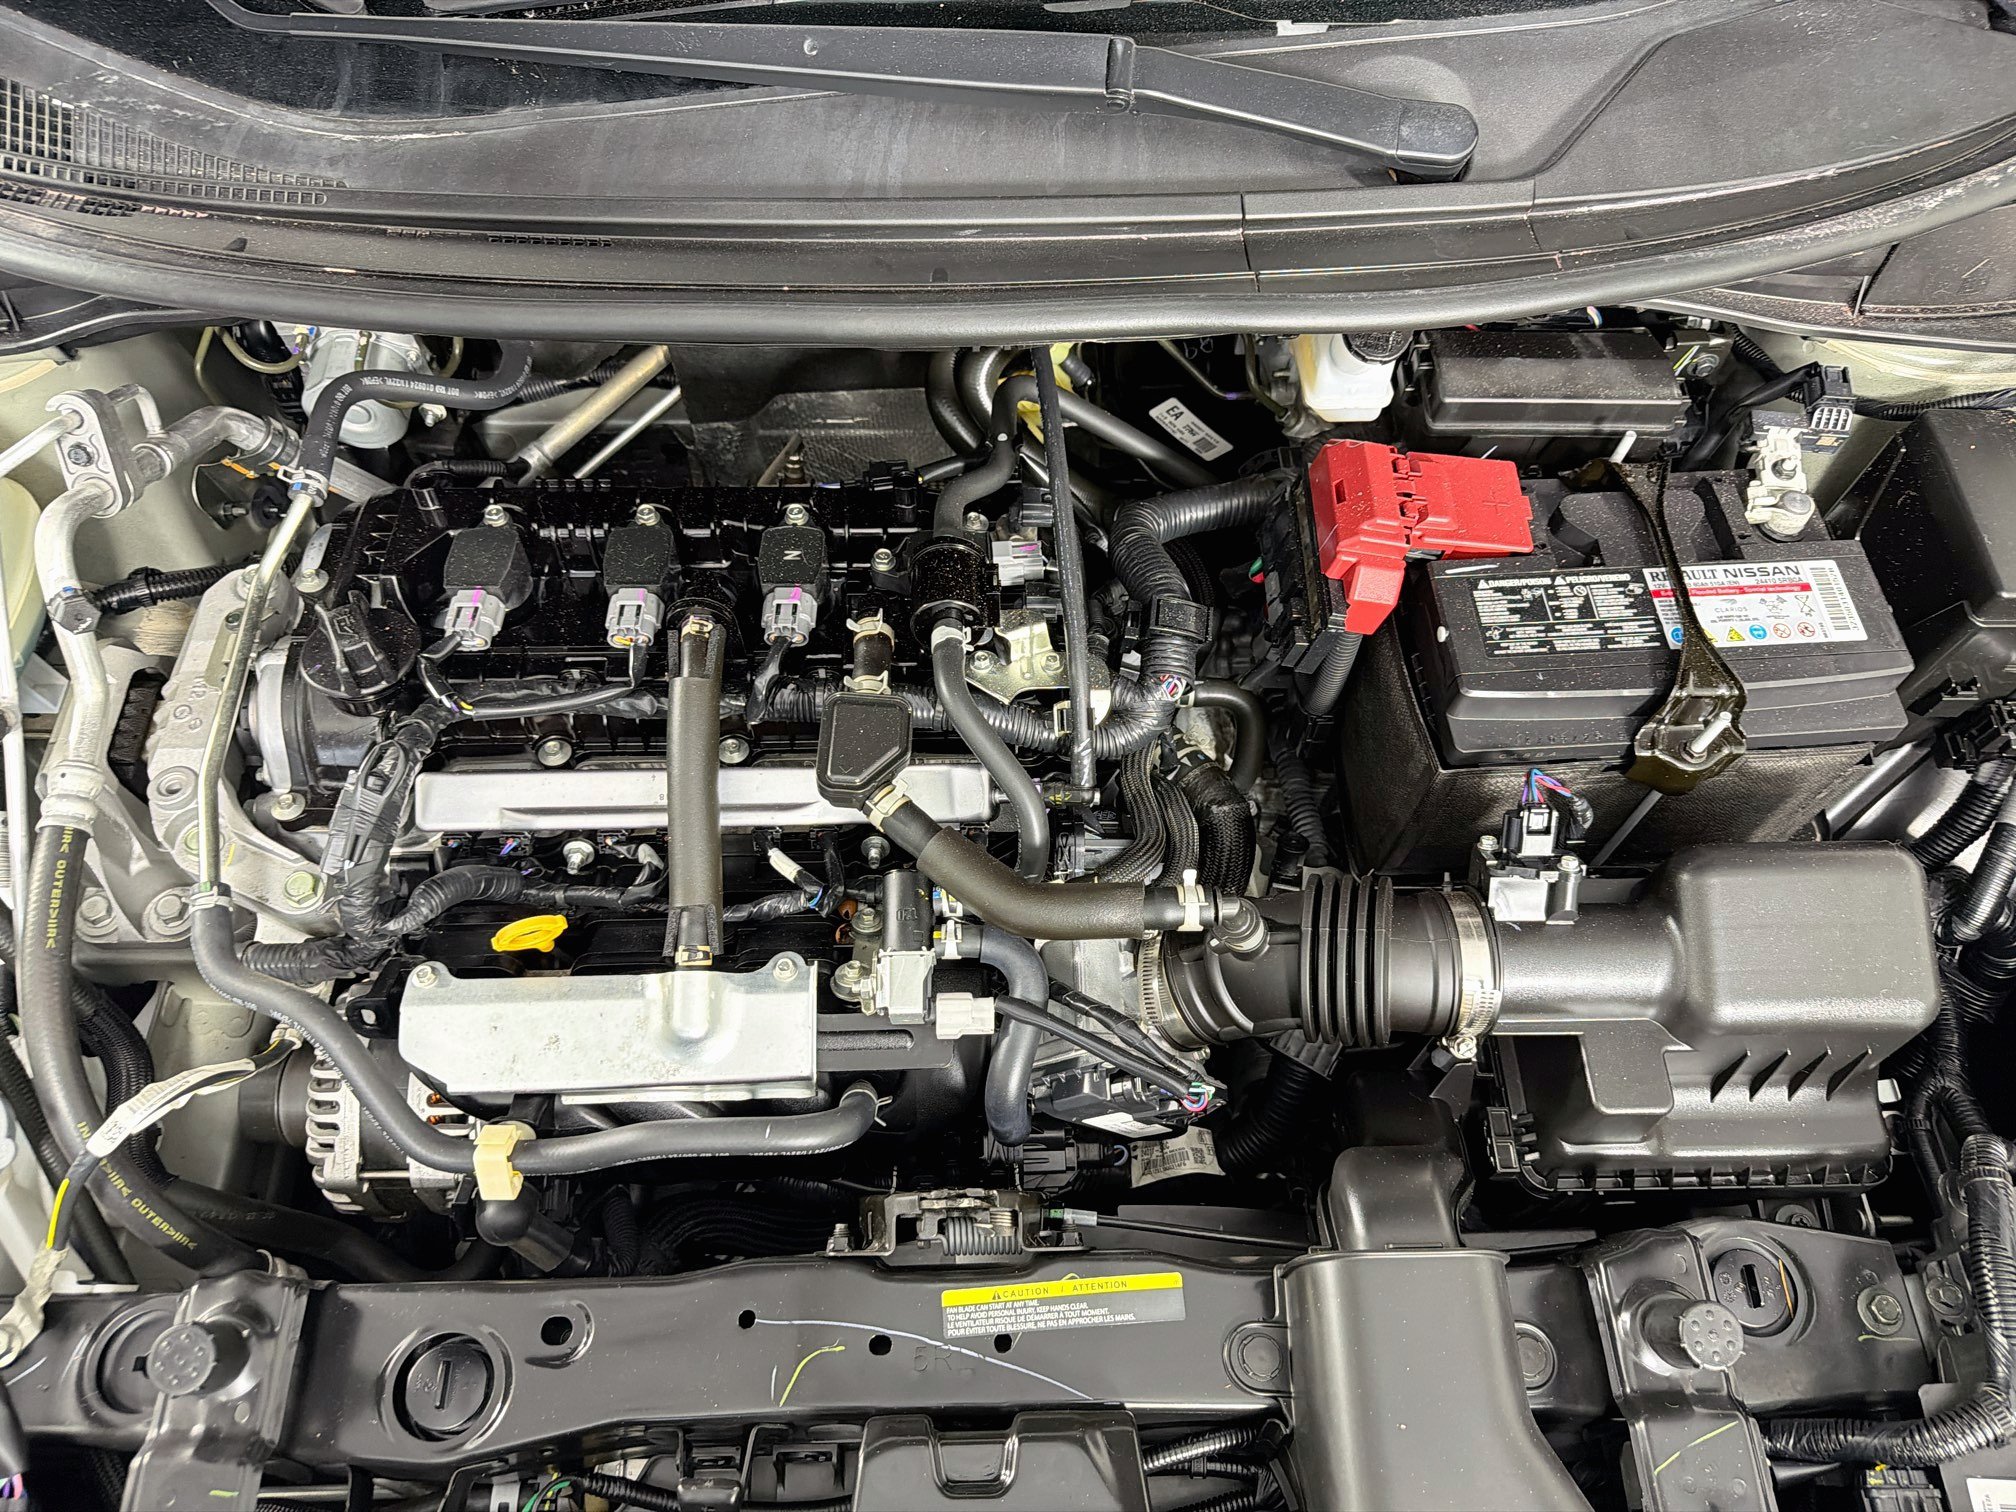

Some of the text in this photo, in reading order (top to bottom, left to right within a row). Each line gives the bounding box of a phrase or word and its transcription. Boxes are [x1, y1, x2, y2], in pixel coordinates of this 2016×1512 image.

[1165, 405, 1185, 421] EA
[1649, 565, 1801, 582] REAULT NISSAN
[1002, 1287, 1049, 1298] CAUTION
[1072, 1281, 1128, 1292] ATTENTION
[947, 1314, 955, 1322] TO
[956, 1313, 970, 1321] HELP
[970, 1311, 987, 1319] AVOID
[988, 1309, 1016, 1318] PERSONAL
[1036, 1305, 1049, 1313] KEEP
[1050, 1303, 1069, 1312] HANDS
[1070, 1302, 1088, 1310] CLEAR.
[958, 1305, 975, 1313] BLADE
[989, 1302, 1005, 1310] START
[1006, 1301, 1013, 1309] AT
[1013, 1300, 1025, 1308] ANY
[948, 1328, 965, 1336] POUR
[966, 1326, 985, 1335] ÉVITER
[986, 1324, 1005, 1333] TOUTE
[1038, 1320, 1046, 1328] NE
[1047, 1319, 1058, 1327] PAS
[1067, 1315, 1103, 1326] APPROCHER
[1104, 1315, 1114, 1323] LES
[1115, 1313, 1136, 1321] MAINS.
[955, 1318, 994, 1329] VENTILATEUR
[995, 1316, 1016, 1325] RISQUE
[1026, 1311, 1059, 1322] DÉMARRER
[1065, 1310, 1080, 1318] TOUT
[1081, 1307, 1109, 1317] MOMENT.
